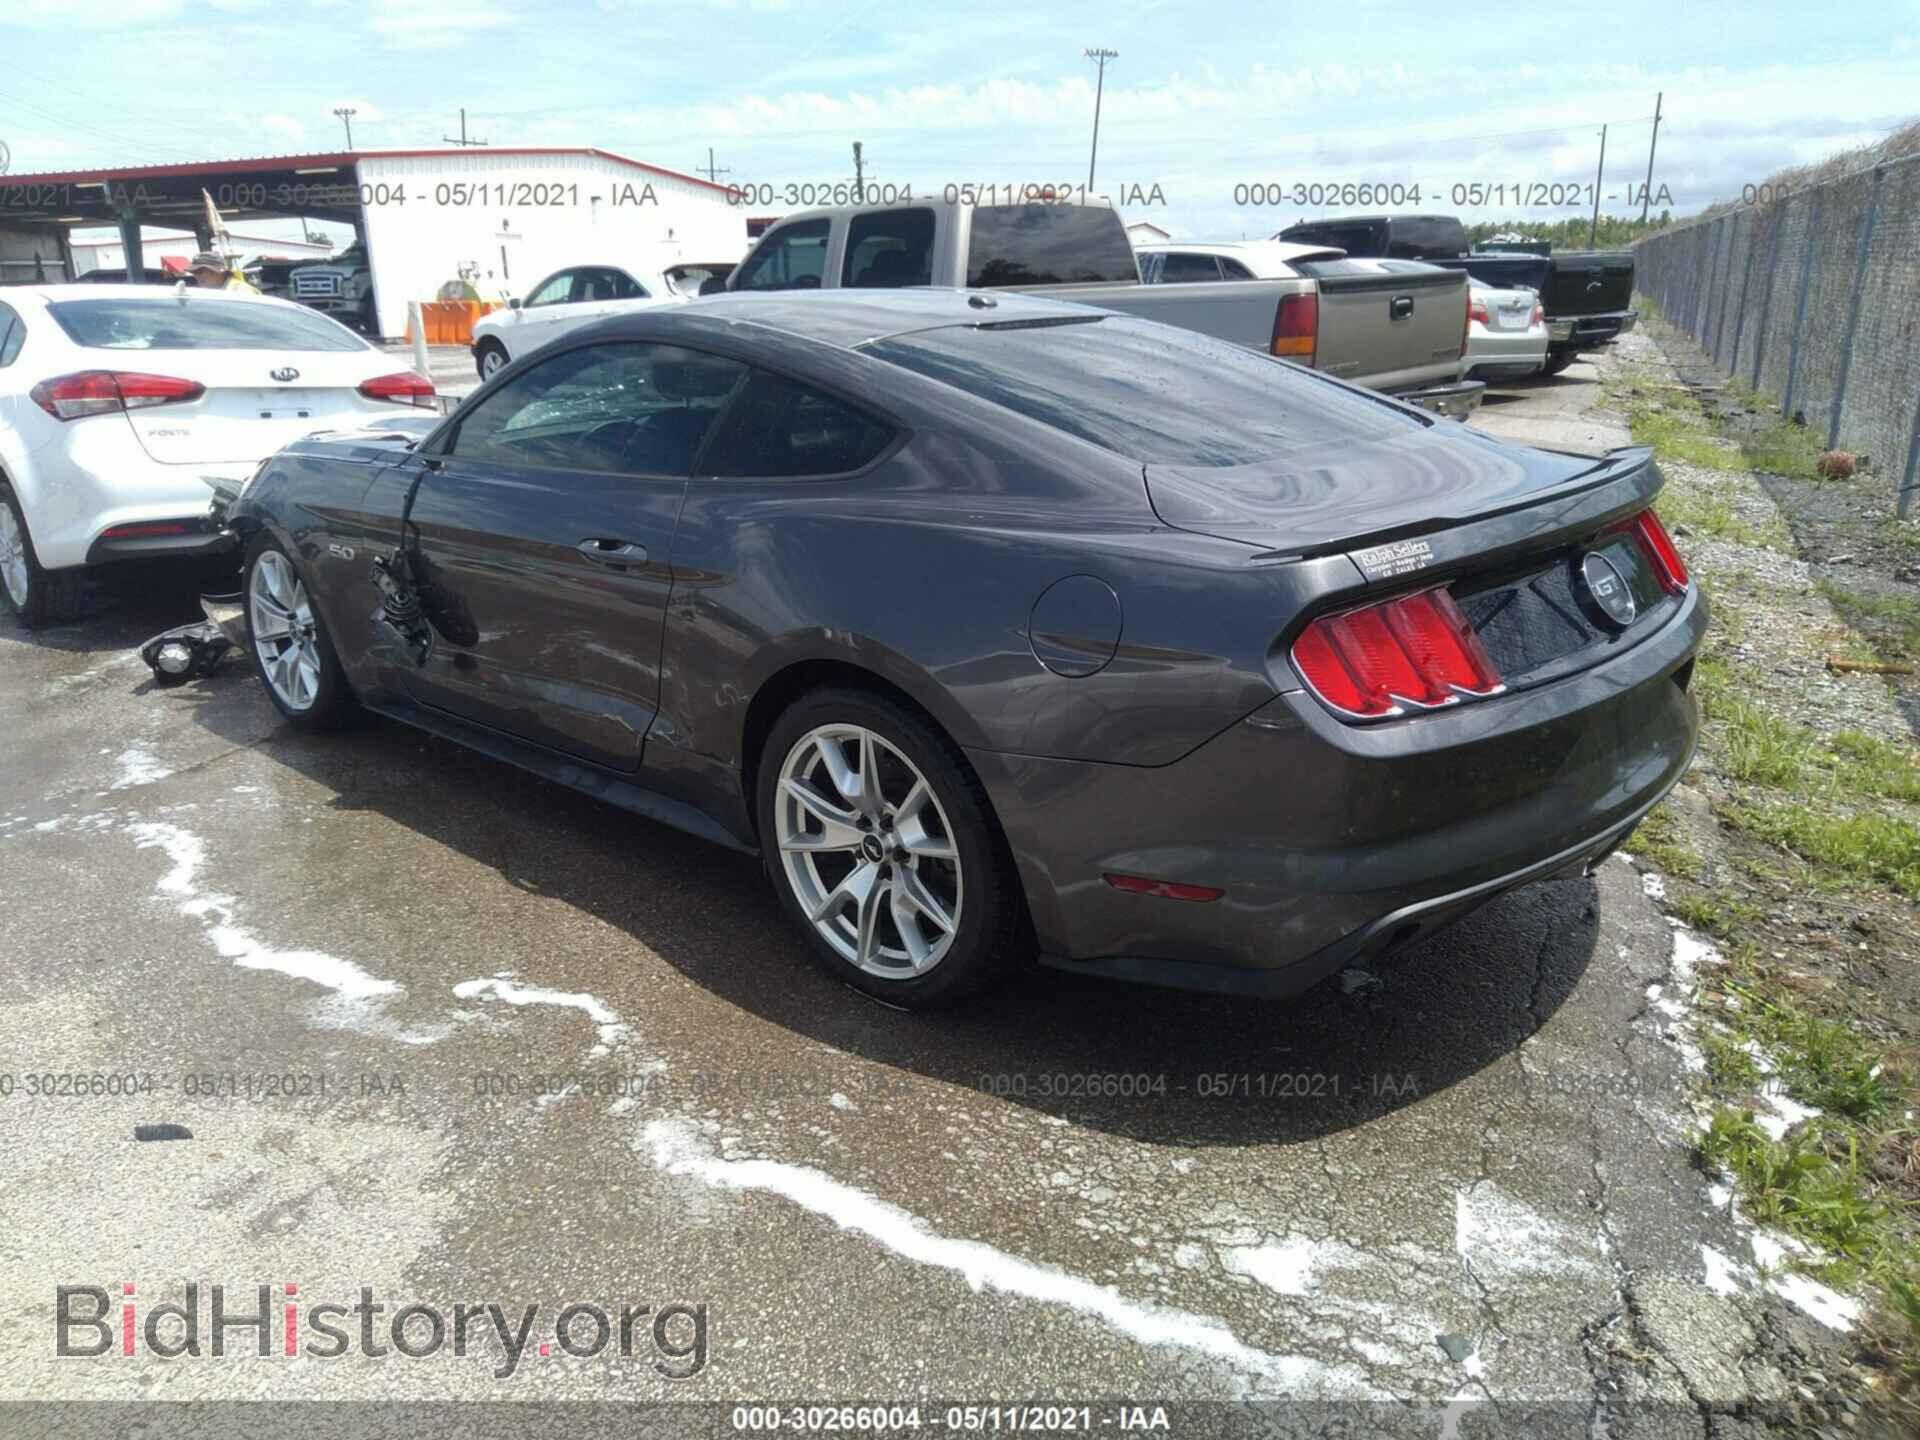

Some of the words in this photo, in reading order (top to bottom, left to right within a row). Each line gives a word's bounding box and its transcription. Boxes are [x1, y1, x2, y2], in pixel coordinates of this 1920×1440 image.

[1360, 547, 1395, 567] Ralph
[1392, 541, 1432, 558] Sellers
[1593, 574, 1620, 597] GT
